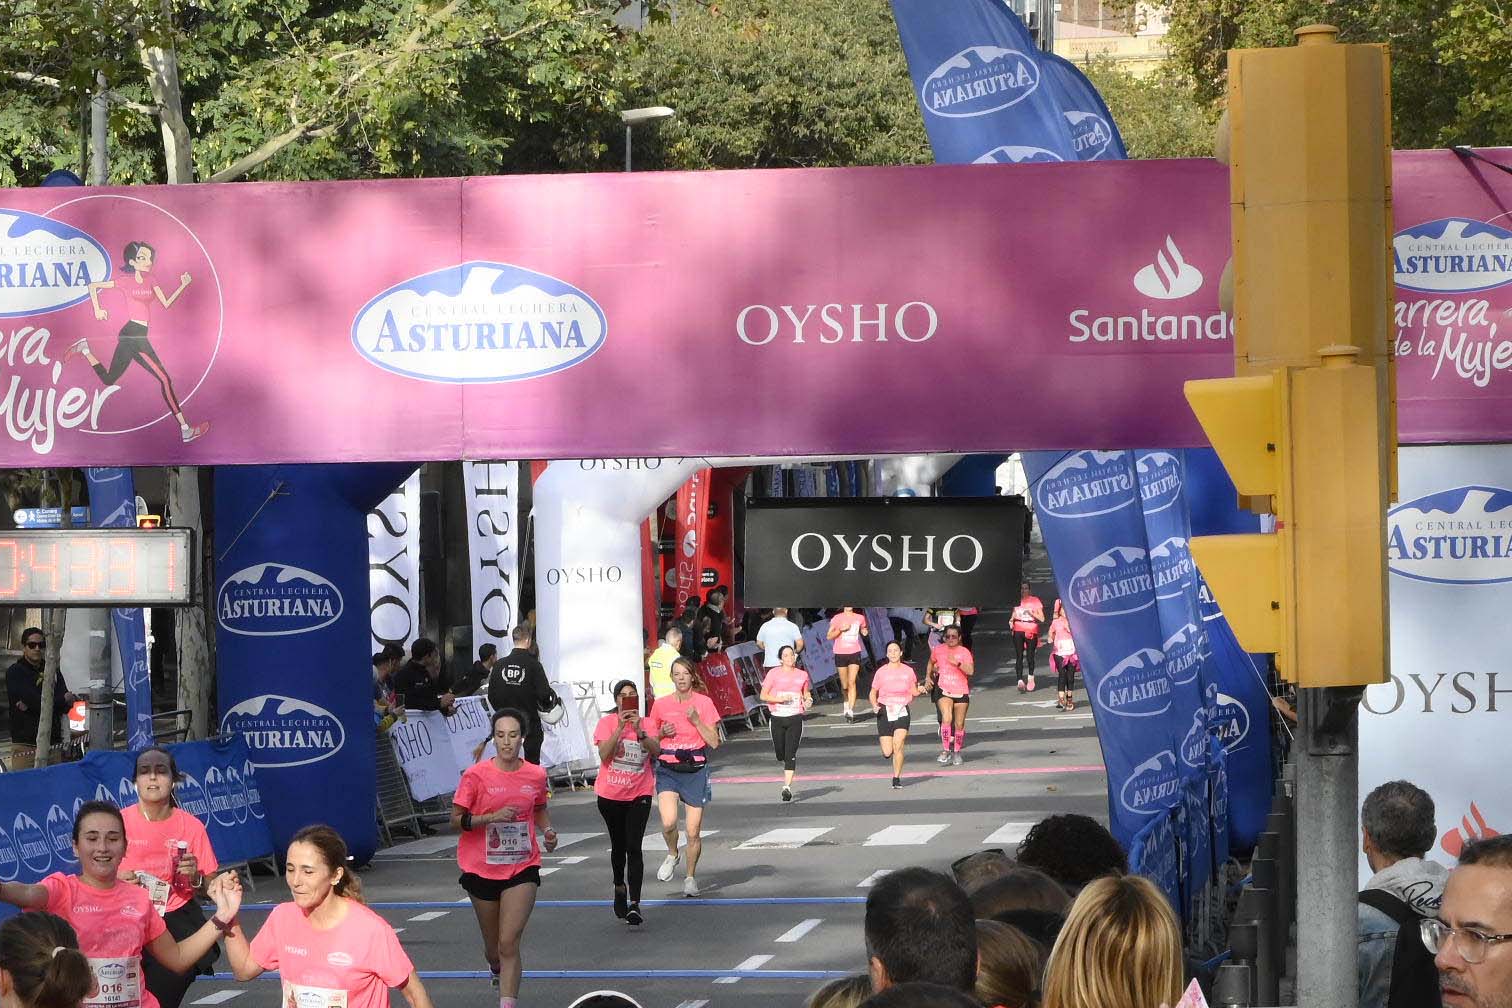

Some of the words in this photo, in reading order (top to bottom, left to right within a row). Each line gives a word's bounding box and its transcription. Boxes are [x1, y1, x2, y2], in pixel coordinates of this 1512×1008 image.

[10, 243, 87, 256] LECHERA
[1408, 242, 1460, 252] CENTRAL
[1464, 241, 1512, 251] LECHER
[410, 303, 492, 316] CENTRAL
[498, 301, 579, 315] LECHERA
[1394, 298, 1490, 328] arrera
[371, 308, 587, 354] ASTURIANA
[735, 300, 939, 346] OYSHO
[1068, 308, 1235, 343] Santand
[1418, 327, 1436, 356] la
[1431, 322, 1512, 388] Muje
[1415, 521, 1482, 531] CENTRAL
[789, 532, 984, 575] OYSHO
[546, 565, 623, 586] OYSHO
[234, 588, 276, 597] CENTRAL
[281, 587, 330, 596] LECHERA
[221, 593, 335, 620] ASTURIANA
[507, 669, 520, 679] BP
[1361, 671, 1512, 715] OYSH
[235, 719, 276, 728] CENTRAL
[281, 718, 331, 728] LECHERA
[223, 724, 336, 750] TURIANA
[101, 983, 123, 994] 016
